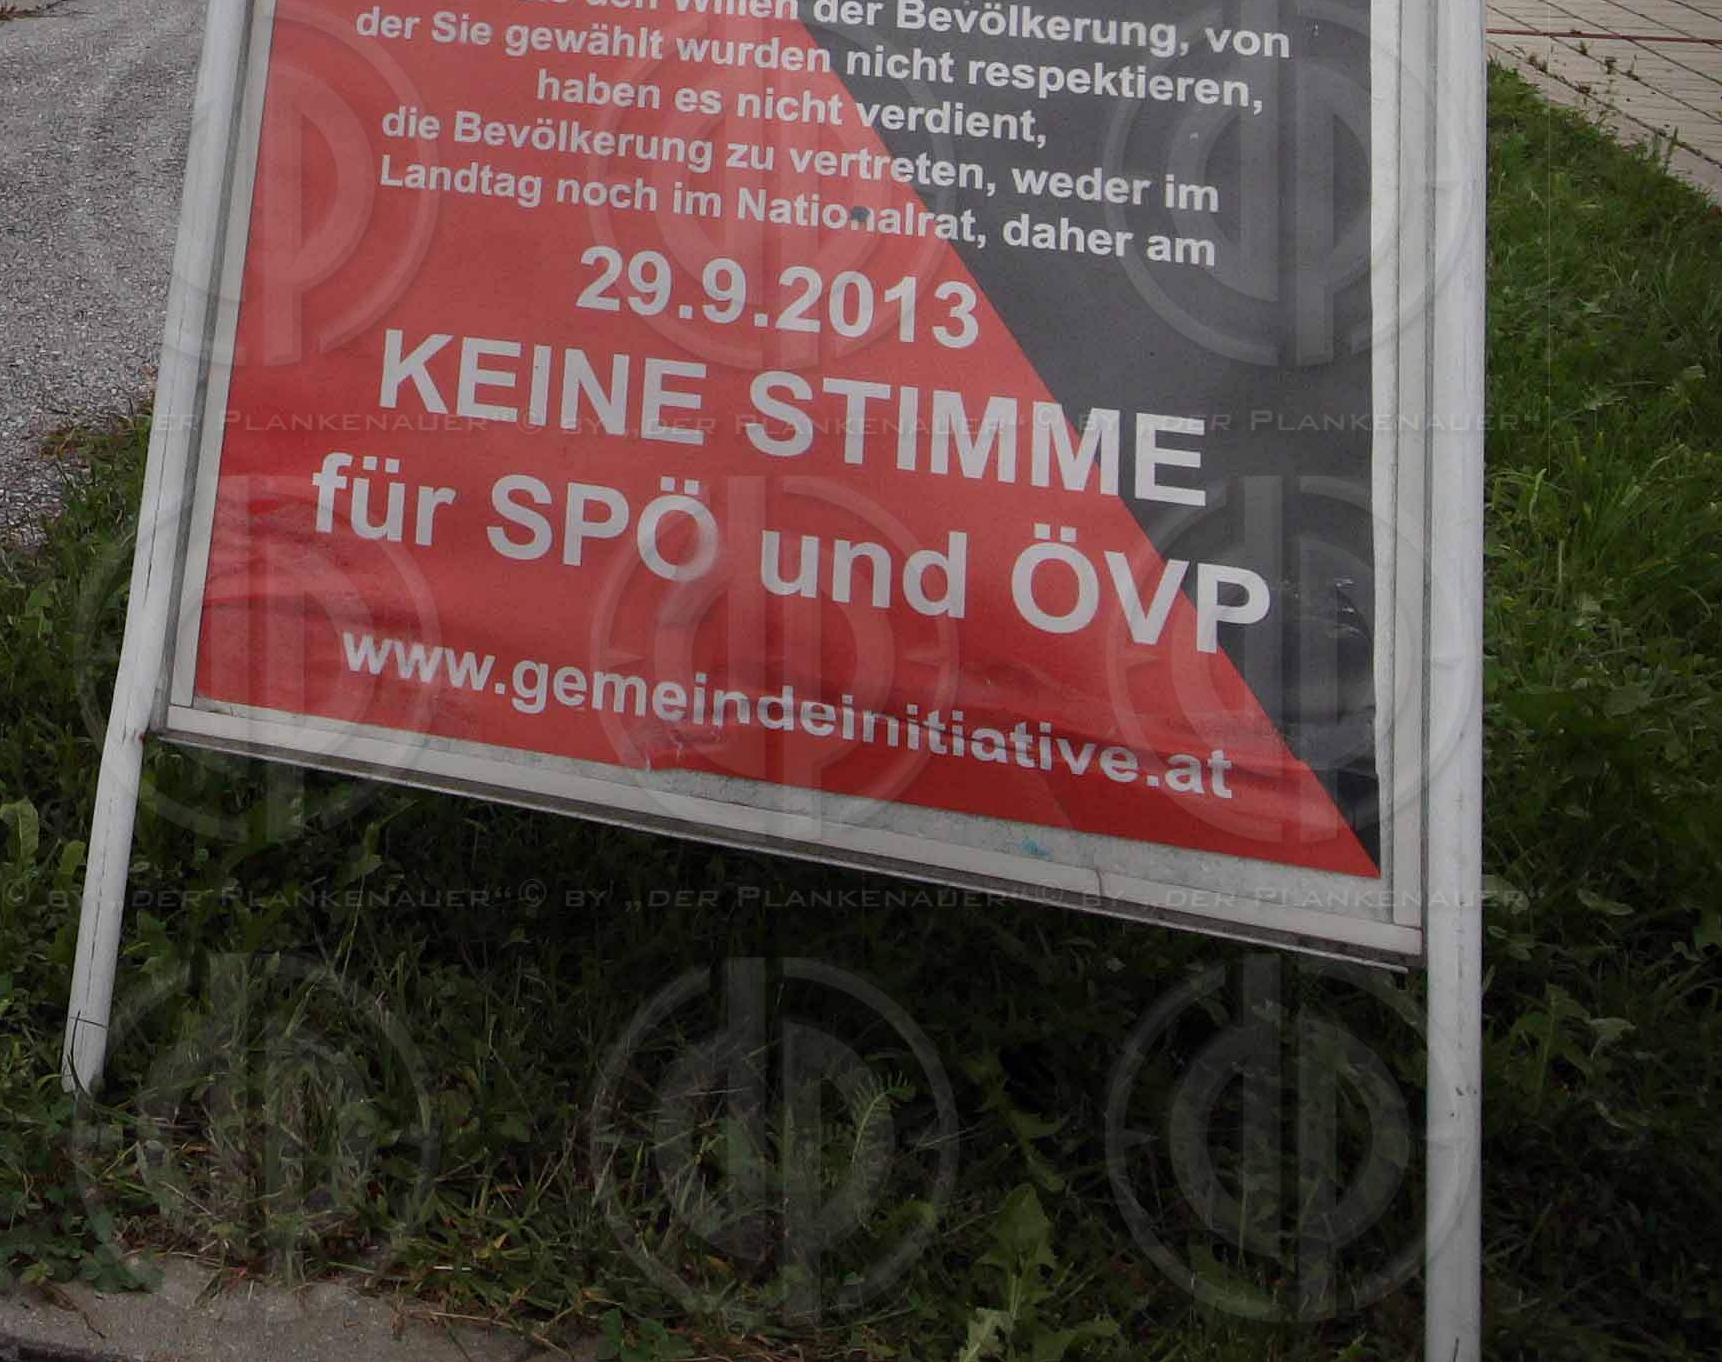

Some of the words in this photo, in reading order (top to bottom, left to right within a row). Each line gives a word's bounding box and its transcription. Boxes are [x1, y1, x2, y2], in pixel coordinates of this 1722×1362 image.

[356, 5, 420, 39] der
[431, 11, 490, 45] Sie
[505, 22, 663, 59] gewählt
[676, 36, 831, 72] wurden
[847, 45, 954, 82] nicht
[968, 57, 1263, 115] respektieren,
[1205, 29, 1289, 57] von
[382, 107, 439, 139] die
[454, 110, 712, 173] Bevölkerung
[727, 144, 773, 169] zu
[790, 149, 995, 196] vertreten,
[1012, 168, 1150, 204] weder
[1166, 175, 1218, 211] im
[538, 69, 660, 109] haben
[676, 89, 721, 113] es
[738, 88, 842, 124] nicht
[856, 102, 1045, 148] verdient,
[381, 155, 541, 207] Landtag
[557, 178, 657, 211] noch
[673, 181, 721, 217] im
[1004, 214, 1133, 256] daher
[1148, 236, 1214, 265] am
[577, 245, 980, 348] 29.9.2013
[379, 329, 707, 444] KEINE
[745, 371, 1206, 507] STIMME
[313, 452, 455, 547] für
[487, 473, 718, 581] SPÖ
[760, 530, 967, 619] und
[1013, 525, 1269, 652] ÖVP
[342, 633, 1233, 798] www.gemeindeinitiative.at
